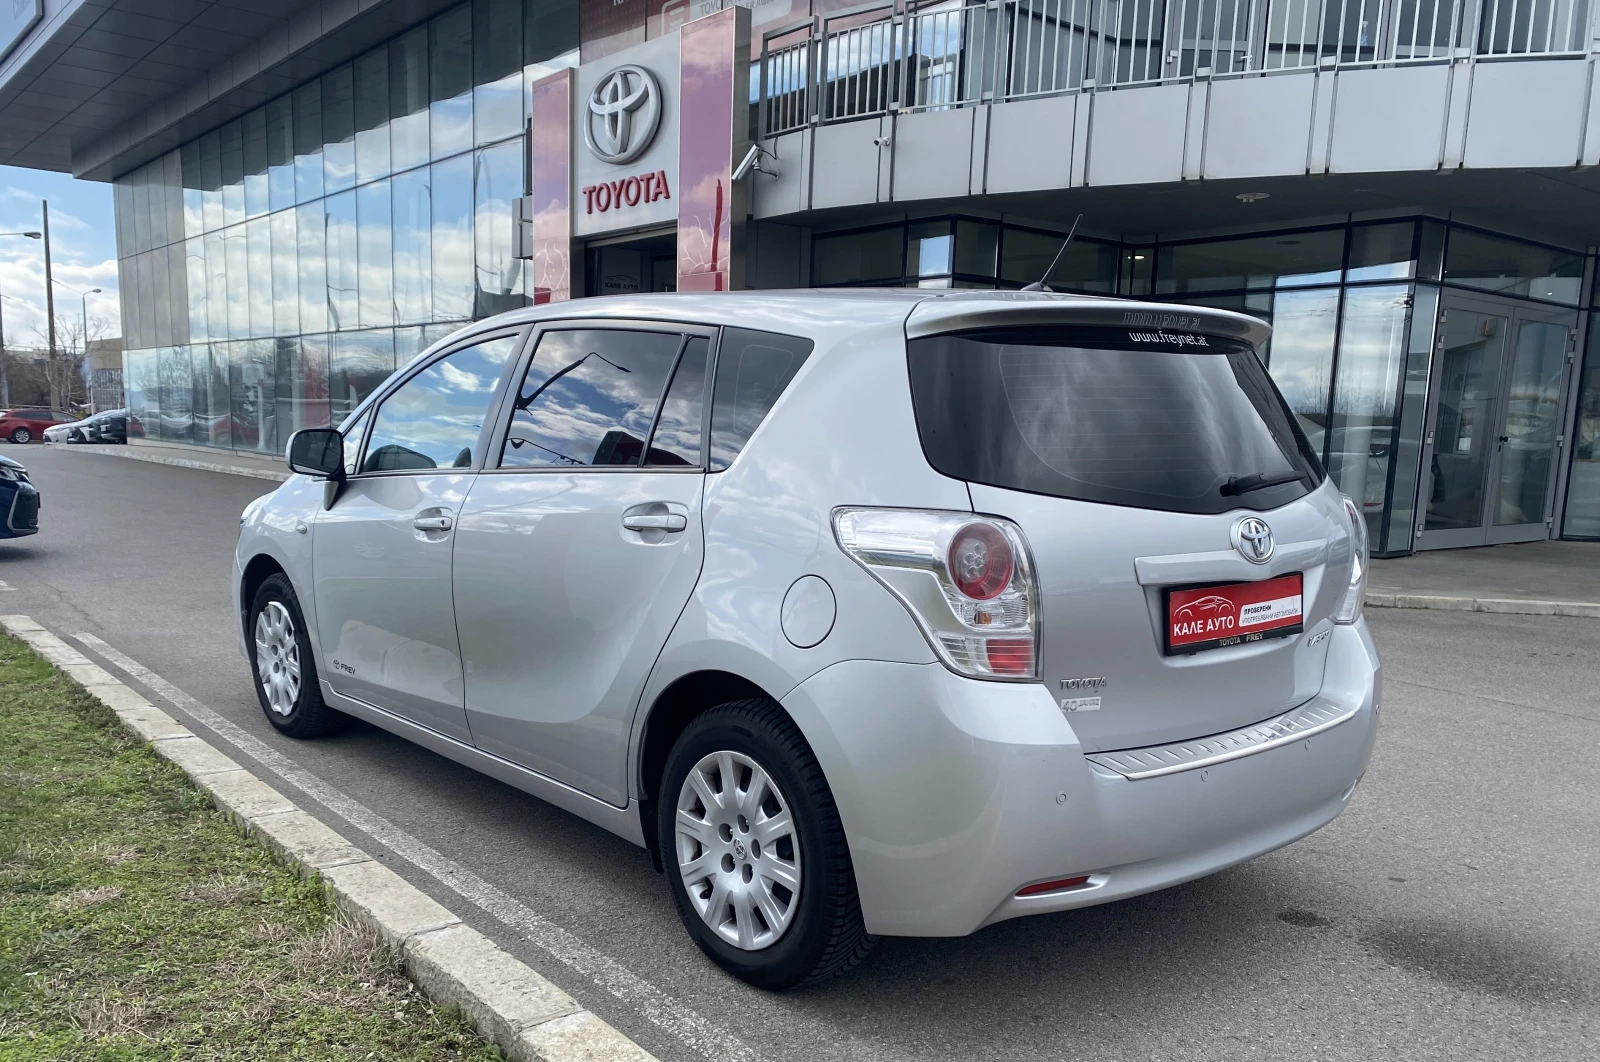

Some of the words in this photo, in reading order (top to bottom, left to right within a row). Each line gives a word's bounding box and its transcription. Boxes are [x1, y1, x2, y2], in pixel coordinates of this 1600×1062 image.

[582, 170, 670, 214] TOYOTA
[1128, 330, 1210, 347] www.freynet.at
[1243, 604, 1272, 615] ПРОВЕРЕНИ
[1173, 620, 1204, 637] КАЛЕ
[1206, 615, 1235, 632] АУТО
[1219, 636, 1241, 646] TOYOTA
[1245, 632, 1264, 642] FREY
[340, 663, 356, 675] FREY
[1060, 676, 1107, 690] TOYOTA
[1062, 700, 1078, 712] 40
